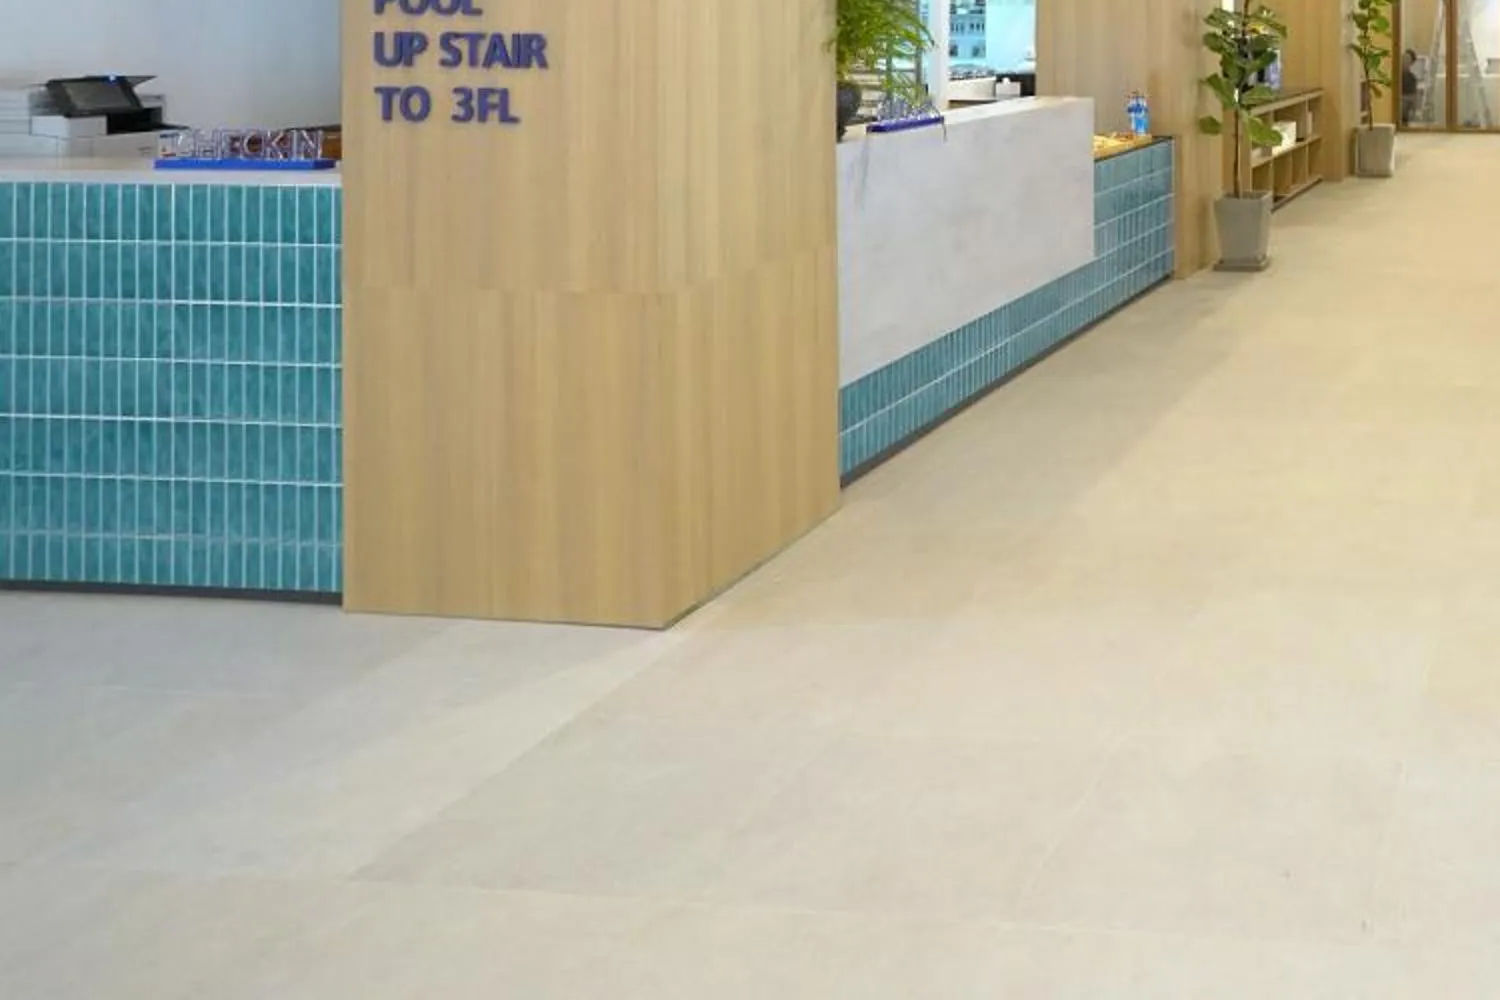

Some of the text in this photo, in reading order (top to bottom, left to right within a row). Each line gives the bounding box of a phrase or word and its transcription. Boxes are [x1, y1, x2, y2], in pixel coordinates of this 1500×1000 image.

[373, 31, 549, 70] UP STAIR
[374, 86, 521, 125] TO 3FL
